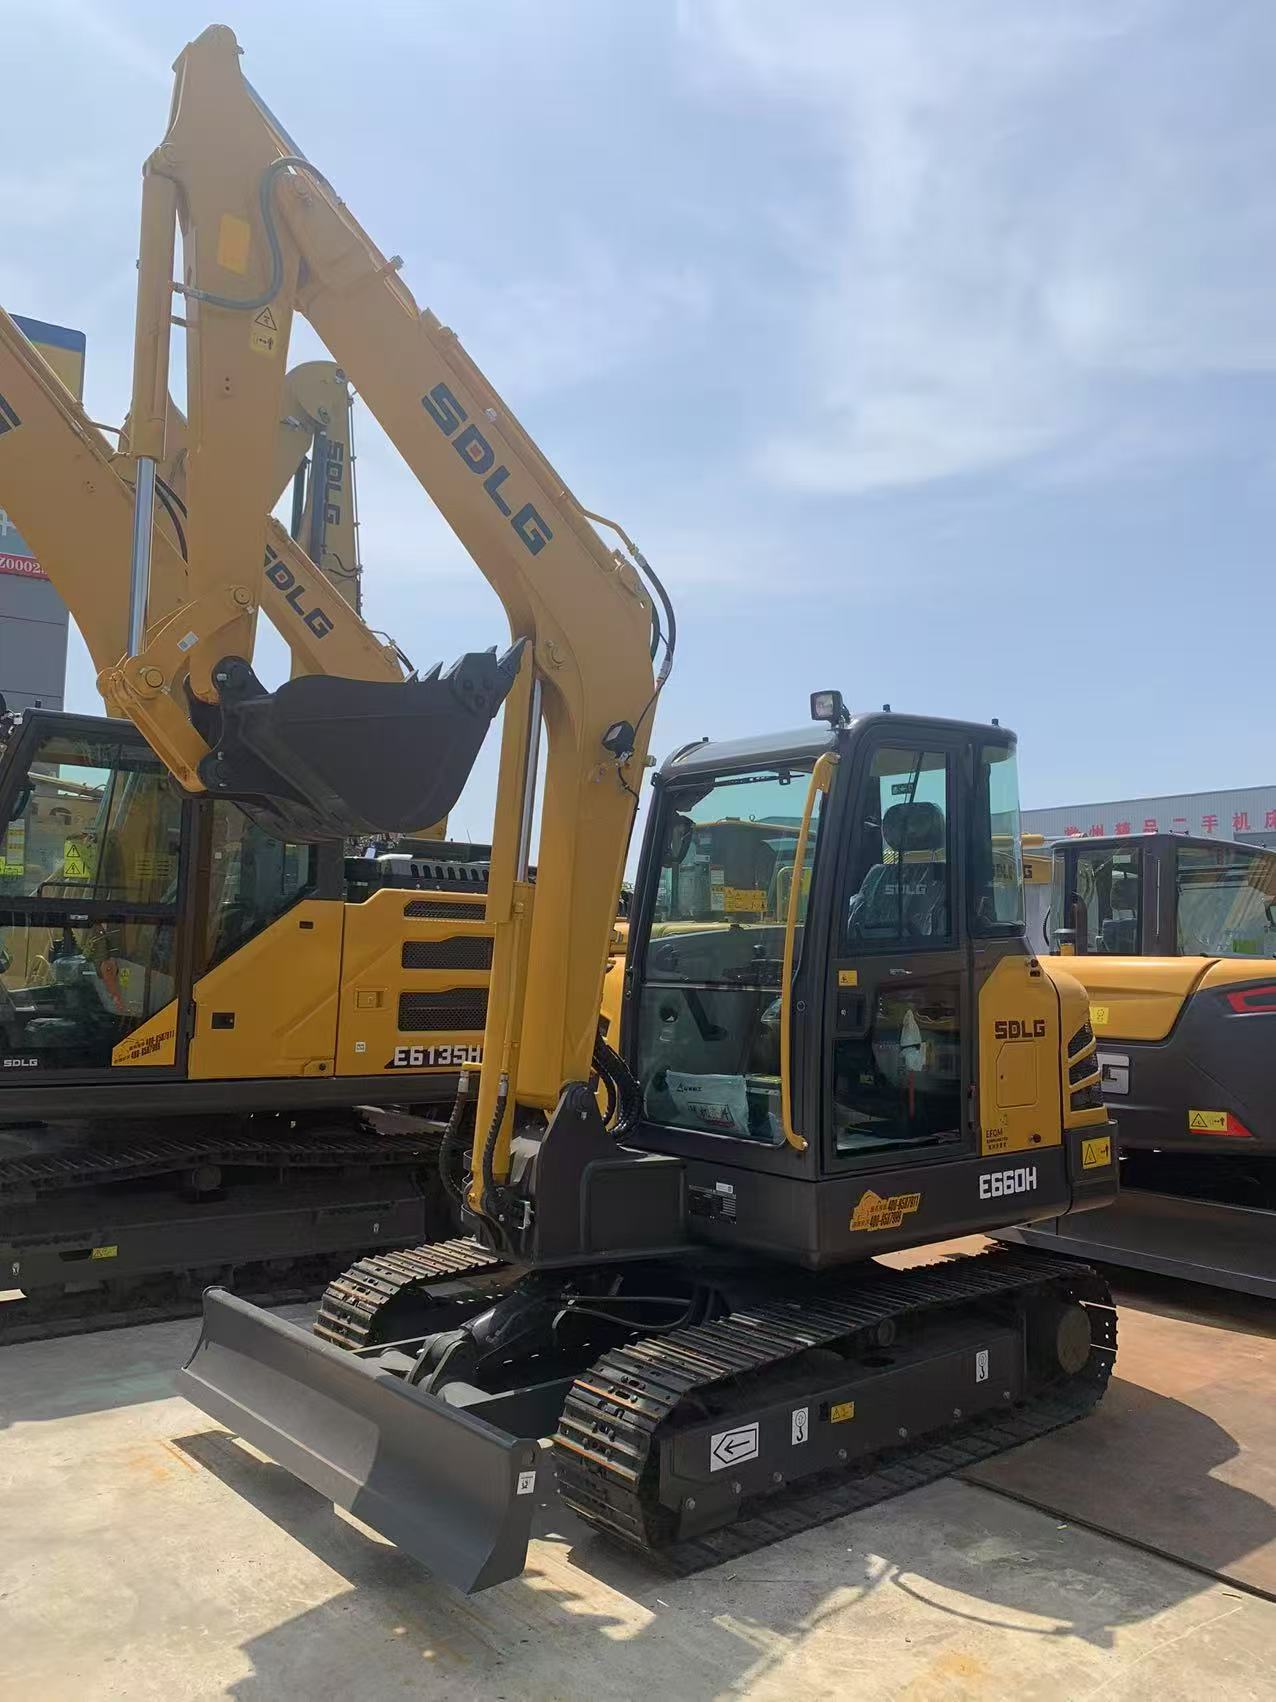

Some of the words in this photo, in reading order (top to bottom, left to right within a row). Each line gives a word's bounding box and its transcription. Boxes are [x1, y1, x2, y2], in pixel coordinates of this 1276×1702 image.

[421, 381, 554, 557] SDLG
[994, 1019, 1046, 1040] SDLG
[3, 1058, 38, 1067] SDLG
[394, 1044, 480, 1066] E6135H
[979, 1166, 1037, 1200] E660H
